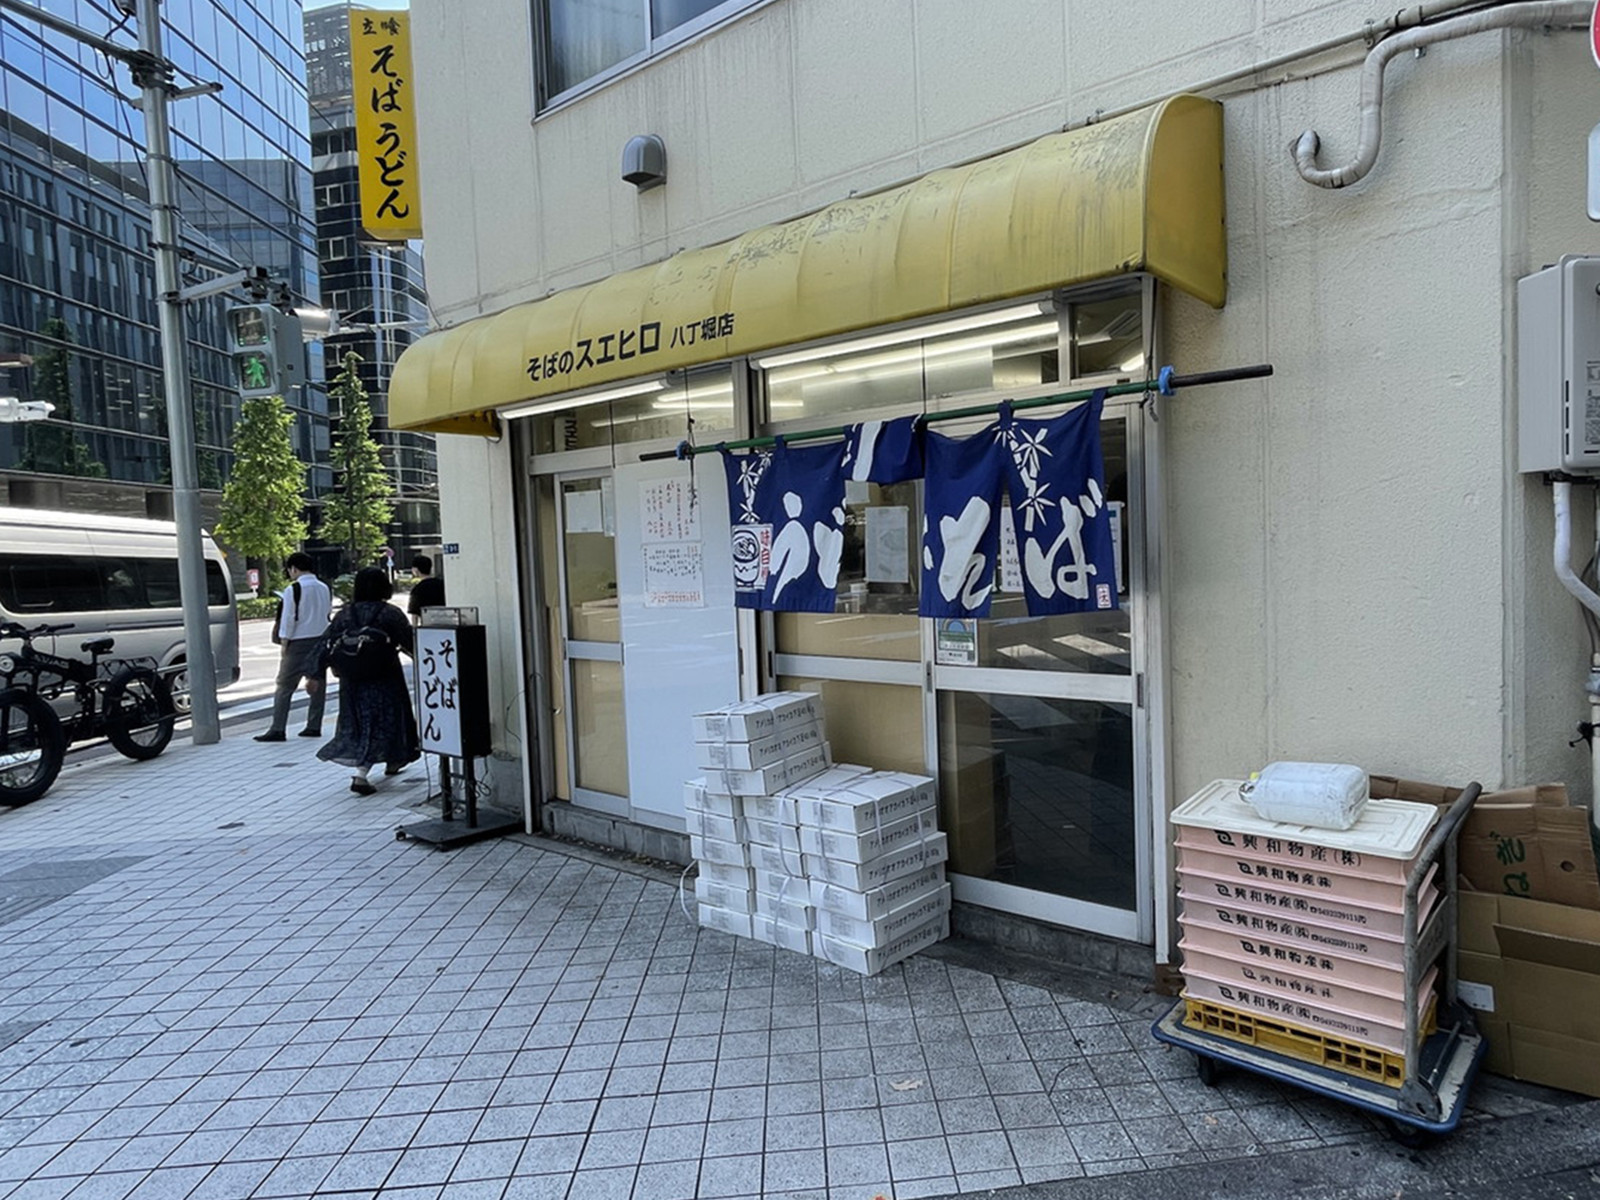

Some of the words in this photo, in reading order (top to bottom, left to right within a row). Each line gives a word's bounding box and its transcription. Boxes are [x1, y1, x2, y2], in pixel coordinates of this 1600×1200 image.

[527, 322, 661, 382] そばのスエヒロ
[670, 313, 735, 348] 八丁堀店
[423, 648, 441, 742] うどん
[438, 639, 458, 710] そば
